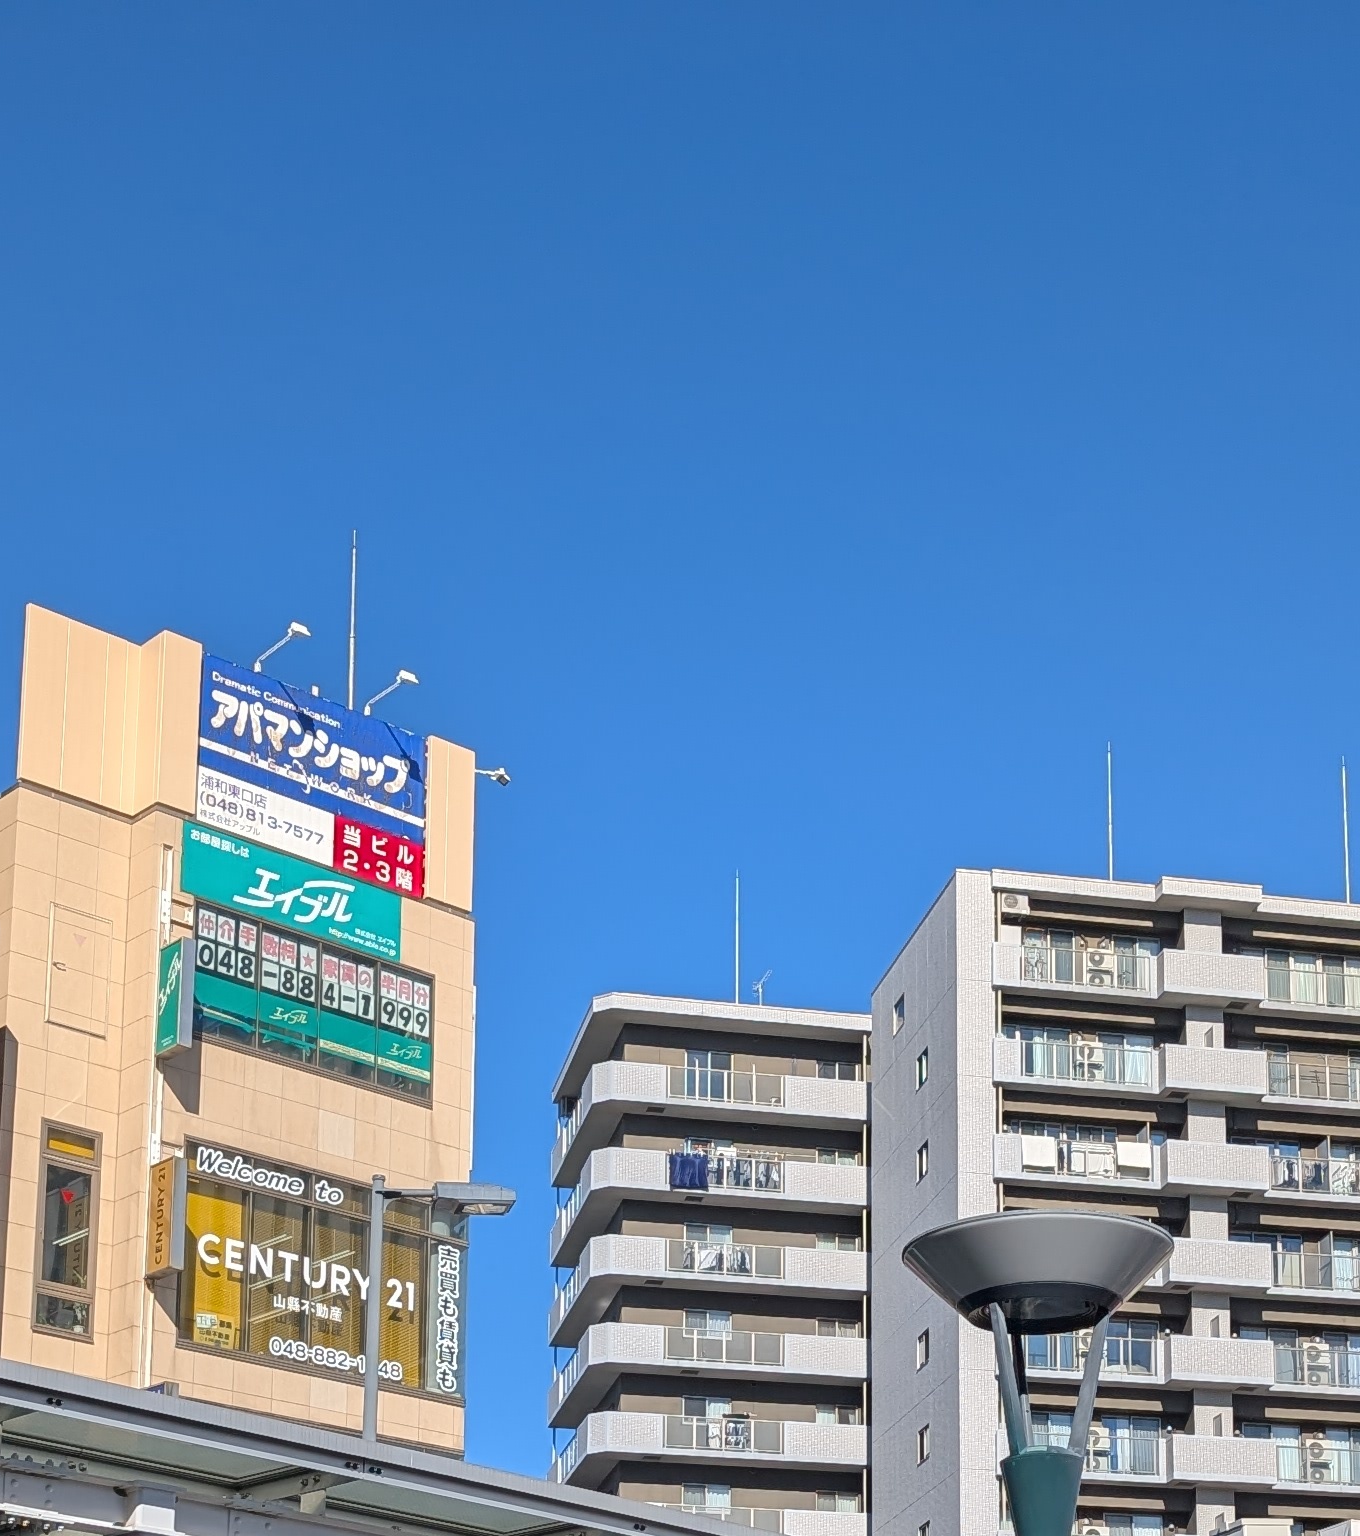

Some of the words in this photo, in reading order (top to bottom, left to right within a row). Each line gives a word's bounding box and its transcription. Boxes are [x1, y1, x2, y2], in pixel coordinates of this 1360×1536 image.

[212, 671, 262, 698] Dramatic
[211, 690, 410, 794] アパマンショップ
[200, 792, 324, 845] (048)813-7577
[201, 773, 267, 809] 浦和東口店
[343, 825, 414, 865] 当ビル
[232, 868, 355, 923] エイブル
[197, 943, 429, 1033] 048-884-1999
[196, 1146, 304, 1195] Welcome
[315, 1180, 344, 1205] to
[155, 1188, 166, 1265] CENTURY
[197, 1233, 370, 1300] CENTURY
[385, 1278, 415, 1311] 21
[437, 1245, 459, 1392] 売買も賃貸も
[270, 1337, 402, 1380] 048-882-148
